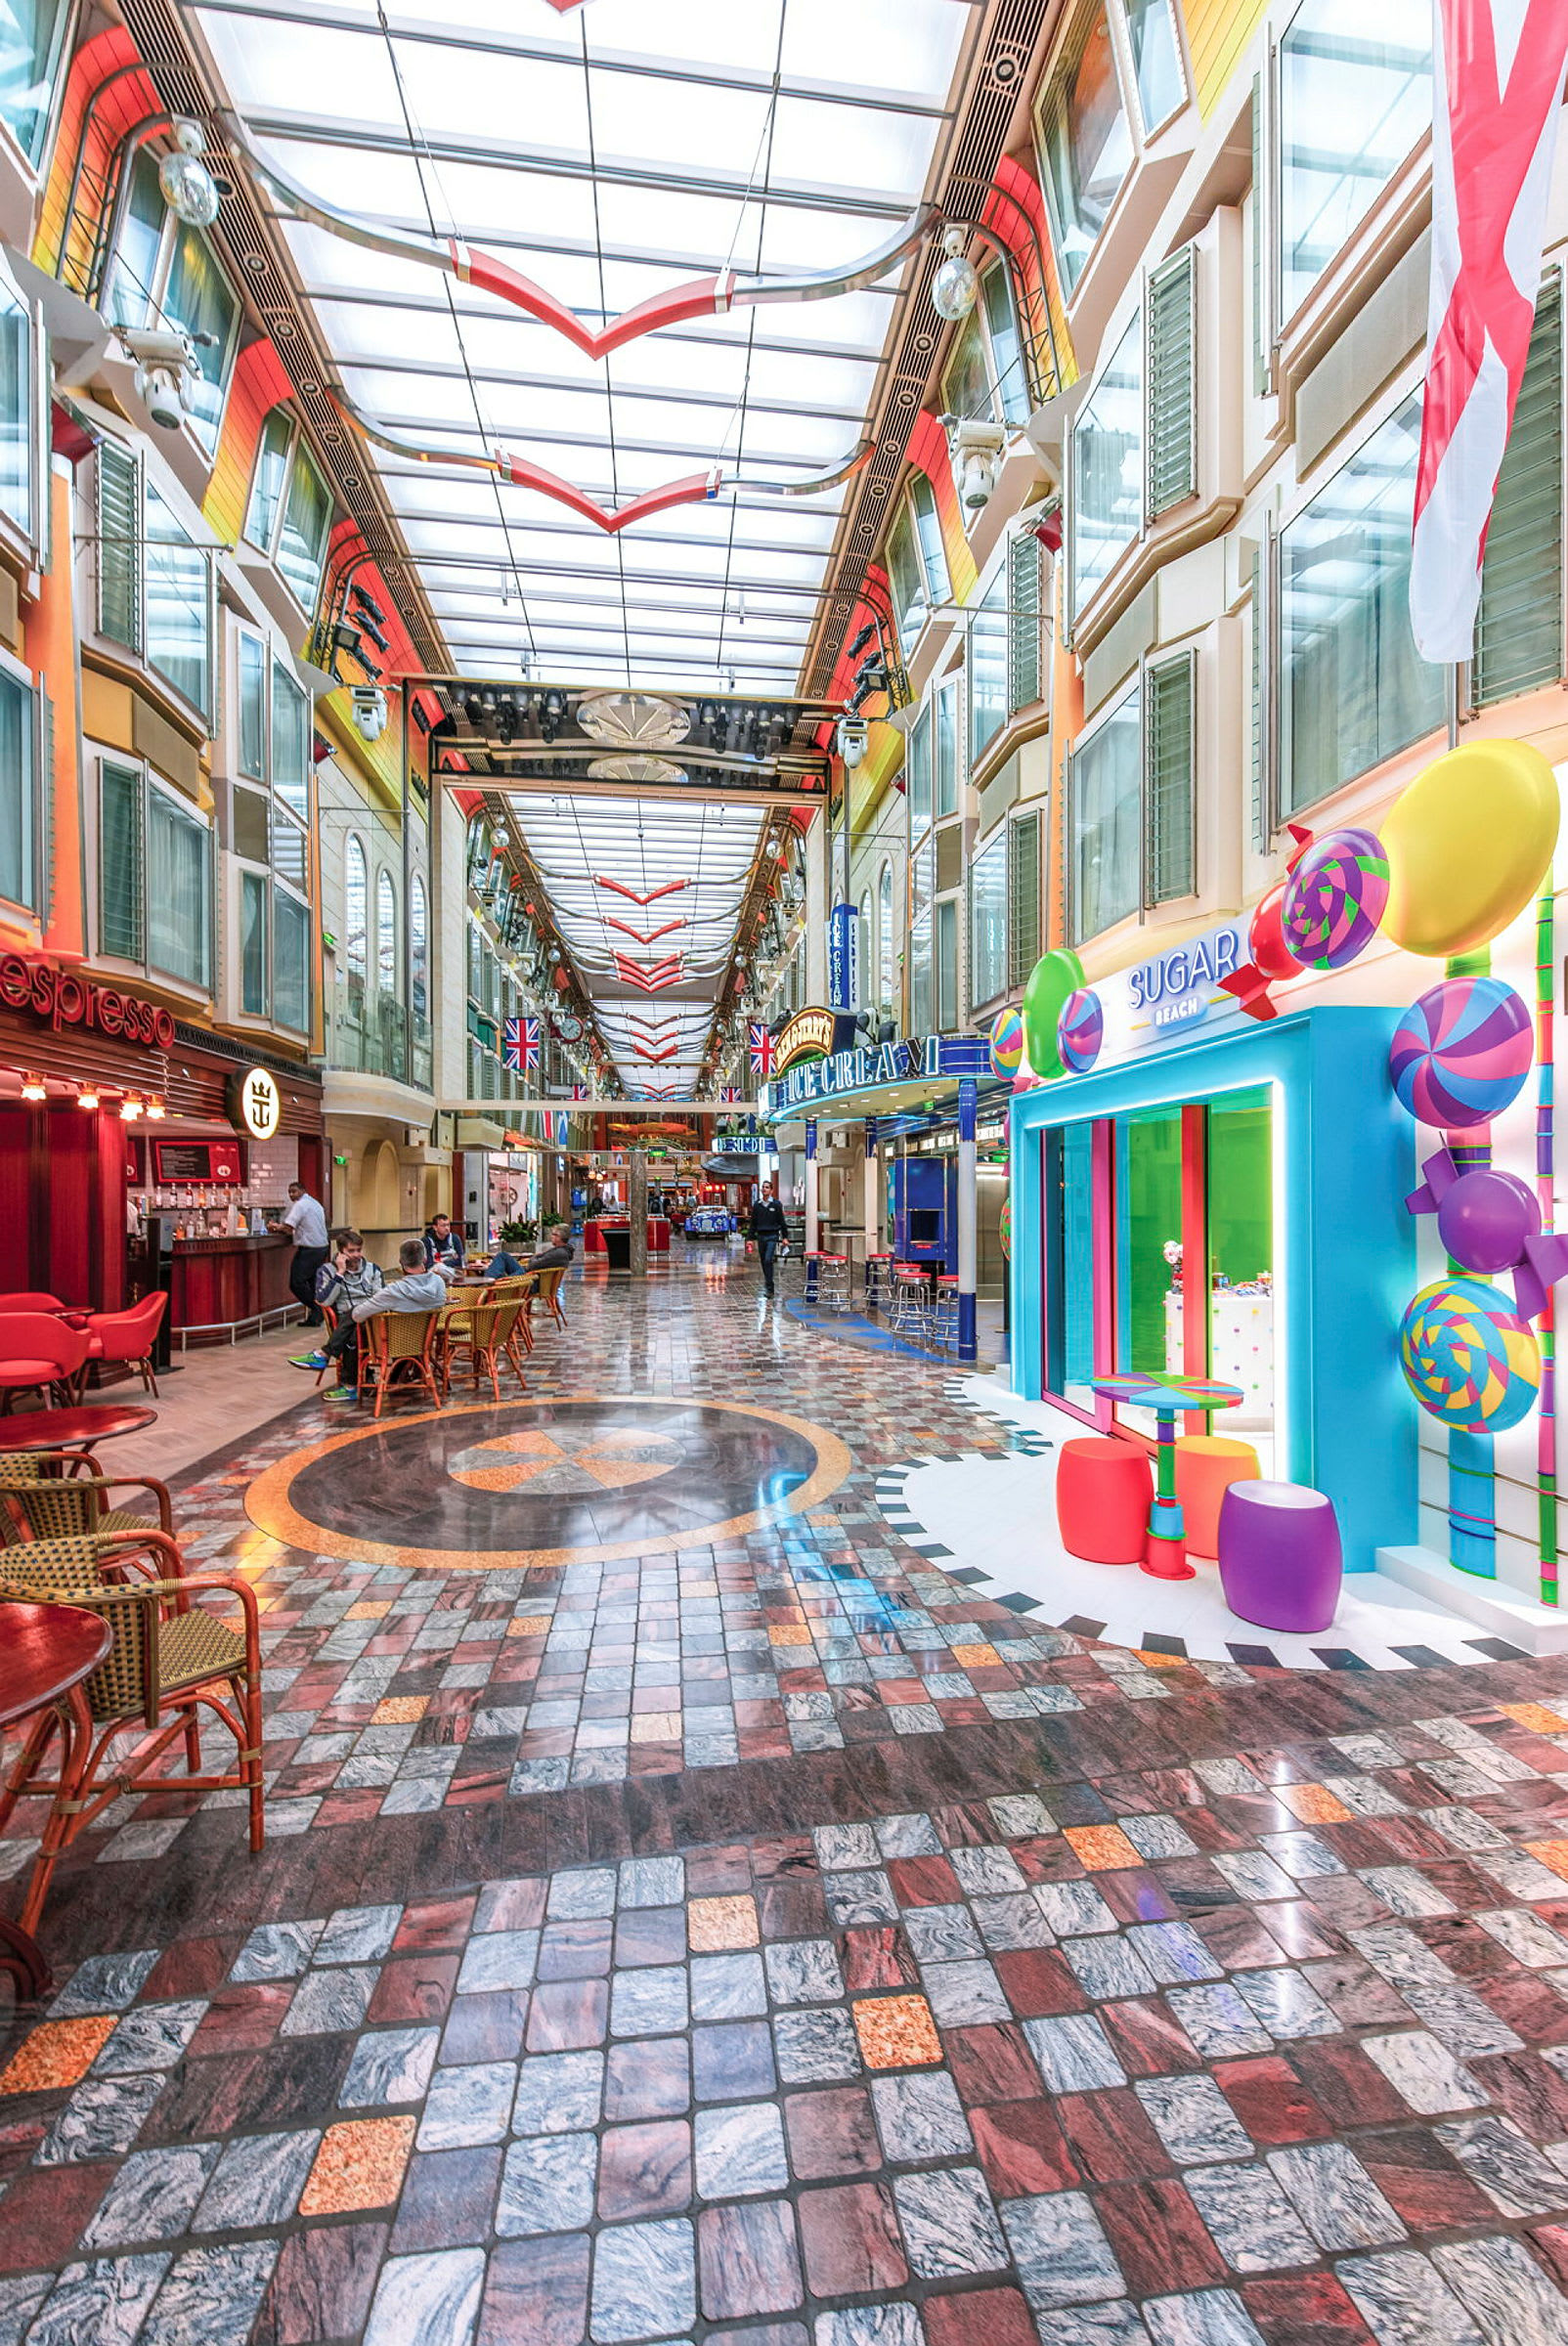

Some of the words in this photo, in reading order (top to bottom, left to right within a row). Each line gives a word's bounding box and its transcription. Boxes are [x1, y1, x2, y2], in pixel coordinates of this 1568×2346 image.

[833, 913, 843, 947] ICE
[832, 950, 843, 1006] CREAM
[1129, 930, 1239, 1009] SUGAR
[0, 955, 176, 1048] espresso
[1154, 997, 1198, 1026] BEACH
[788, 1062, 817, 1102] ICE
[821, 1035, 939, 1093] CREAM
